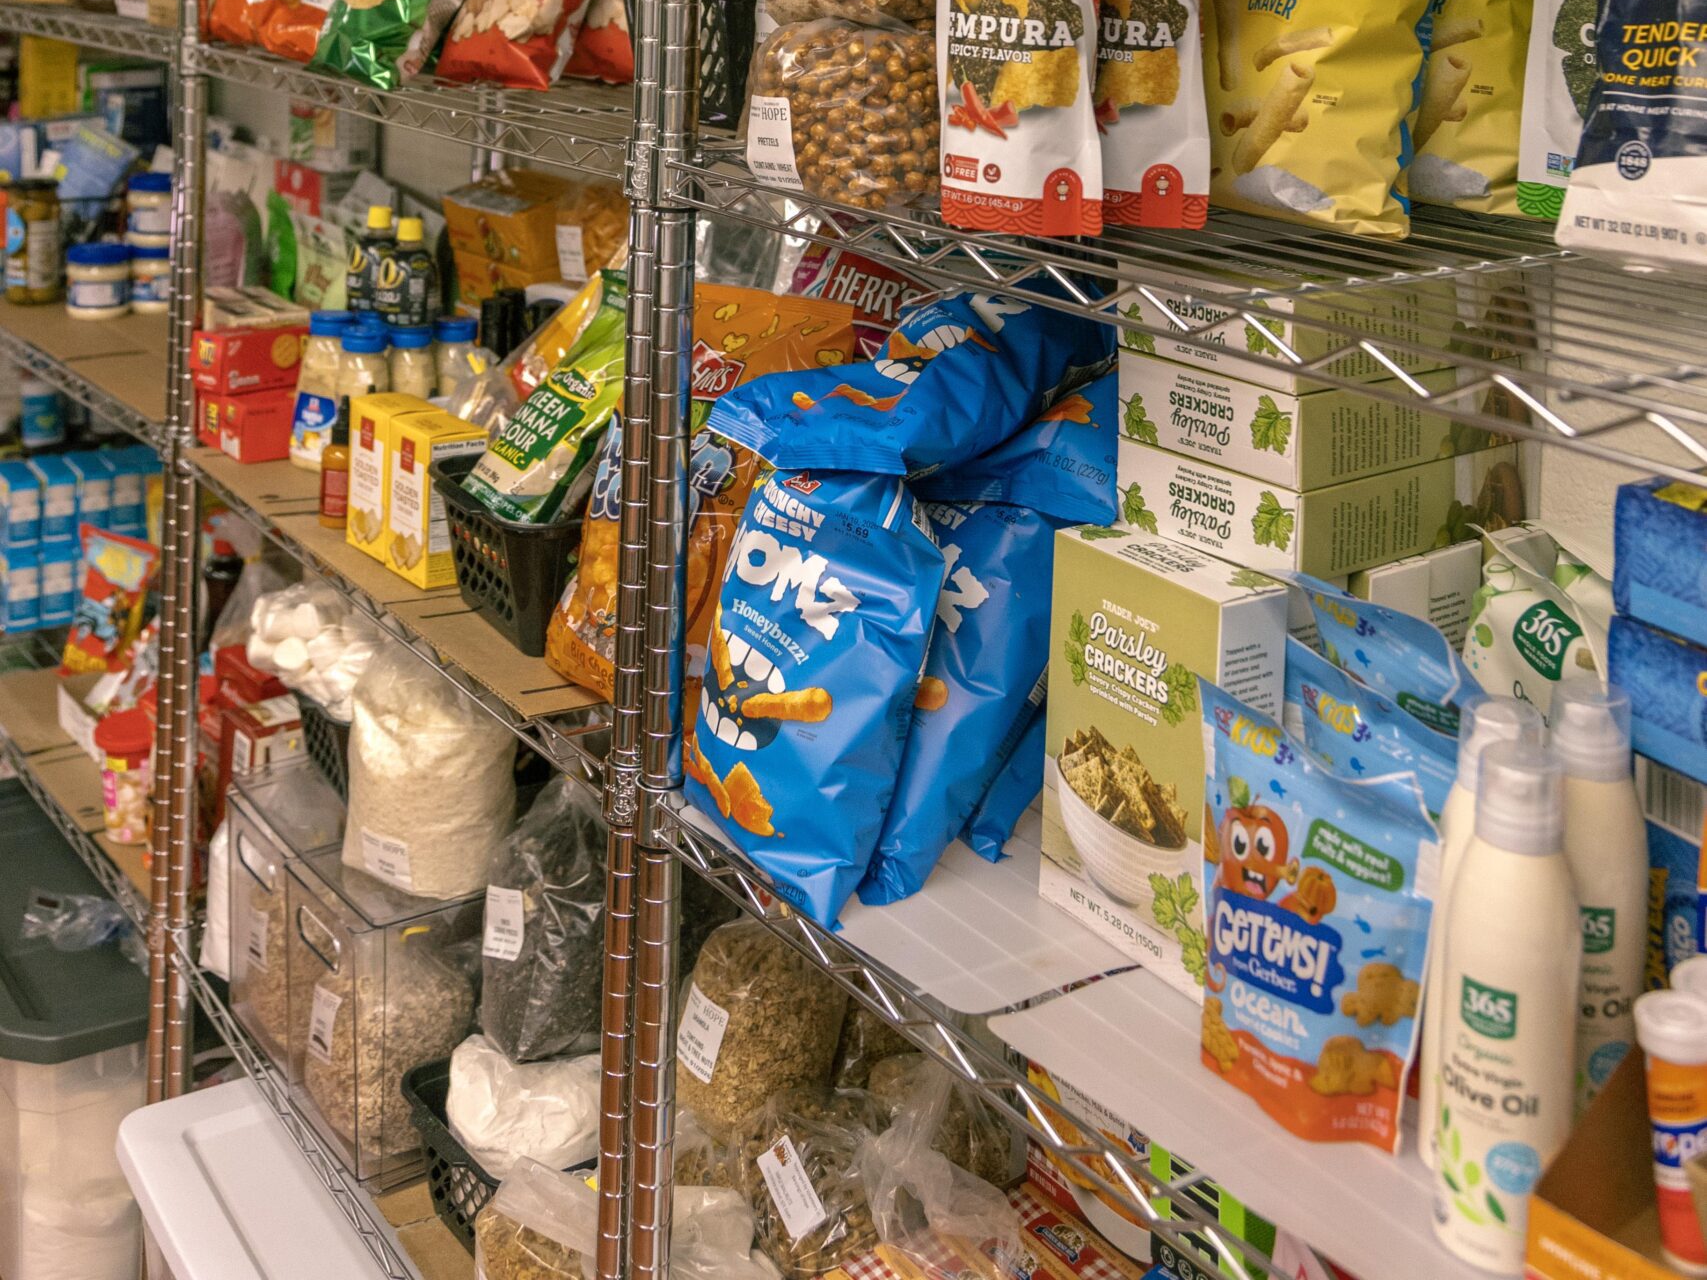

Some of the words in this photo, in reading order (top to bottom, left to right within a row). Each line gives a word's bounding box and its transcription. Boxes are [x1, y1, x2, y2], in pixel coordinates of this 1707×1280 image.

[950, 44, 980, 58] SPICY
[981, 46, 1032, 64] FLAVOR
[1622, 46, 1698, 70] QUICK
[1639, 74, 1672, 88] MEAT
[761, 106, 787, 121] HOPE
[1616, 103, 1647, 114] HOME
[1648, 106, 1670, 115] MEAT
[757, 136, 779, 147] PRETZELS
[955, 167, 976, 179] FREE
[974, 196, 987, 206] OZ
[1574, 215, 1590, 229] NET
[1591, 217, 1605, 231] WT
[1607, 220, 1618, 233] 32
[1619, 222, 1632, 234] OZ
[1644, 224, 1660, 240] LB)
[1661, 227, 1679, 242] 907
[563, 373, 597, 401] Organic
[1175, 382, 1197, 394] Crackers
[1195, 378, 1207, 387] with
[1169, 390, 1234, 422] CRACKERS
[1170, 408, 1230, 446] Parsley
[433, 441, 464, 451] Nutrition
[465, 440, 485, 449] Facts
[1198, 443, 1222, 456] TRADER
[1053, 455, 1062, 469] 8
[1077, 461, 1111, 486] (227g)
[1175, 473, 1197, 485] Crackers
[1195, 470, 1207, 479] with
[1168, 481, 1235, 516] CRACKERS
[1170, 497, 1231, 540] Parsley
[1198, 535, 1223, 549] TRADER
[1126, 543, 1194, 573] CRACKERS
[1102, 599, 1132, 622] TRADER
[1134, 615, 1160, 633] JOE'S
[732, 598, 810, 666] Honeybuzz!
[743, 625, 763, 643] Sweet
[760, 637, 784, 658] Honey
[1090, 611, 1168, 677] Parsley
[1521, 608, 1573, 656] 365
[570, 640, 586, 669] Big
[1084, 643, 1168, 704] CRACKERS
[1089, 685, 1119, 705] sprinkled
[1119, 700, 1134, 713] with
[1133, 706, 1158, 727] Parsley
[1111, 683, 1132, 701] Crispy
[1131, 694, 1160, 715] Crackers
[1274, 741, 1295, 765] 3+
[1344, 837, 1363, 856] with
[1069, 887, 1086, 906] NET
[1103, 910, 1122, 930] 5.28
[1123, 923, 1135, 939] OZ
[1135, 931, 1164, 960] (150g)
[702, 1004, 726, 1027] HOPE
[1230, 980, 1308, 1037] Ocean
[1465, 986, 1514, 1025] 365
[1443, 1063, 1495, 1109] Olive
[1501, 1094, 1540, 1116] Oil
